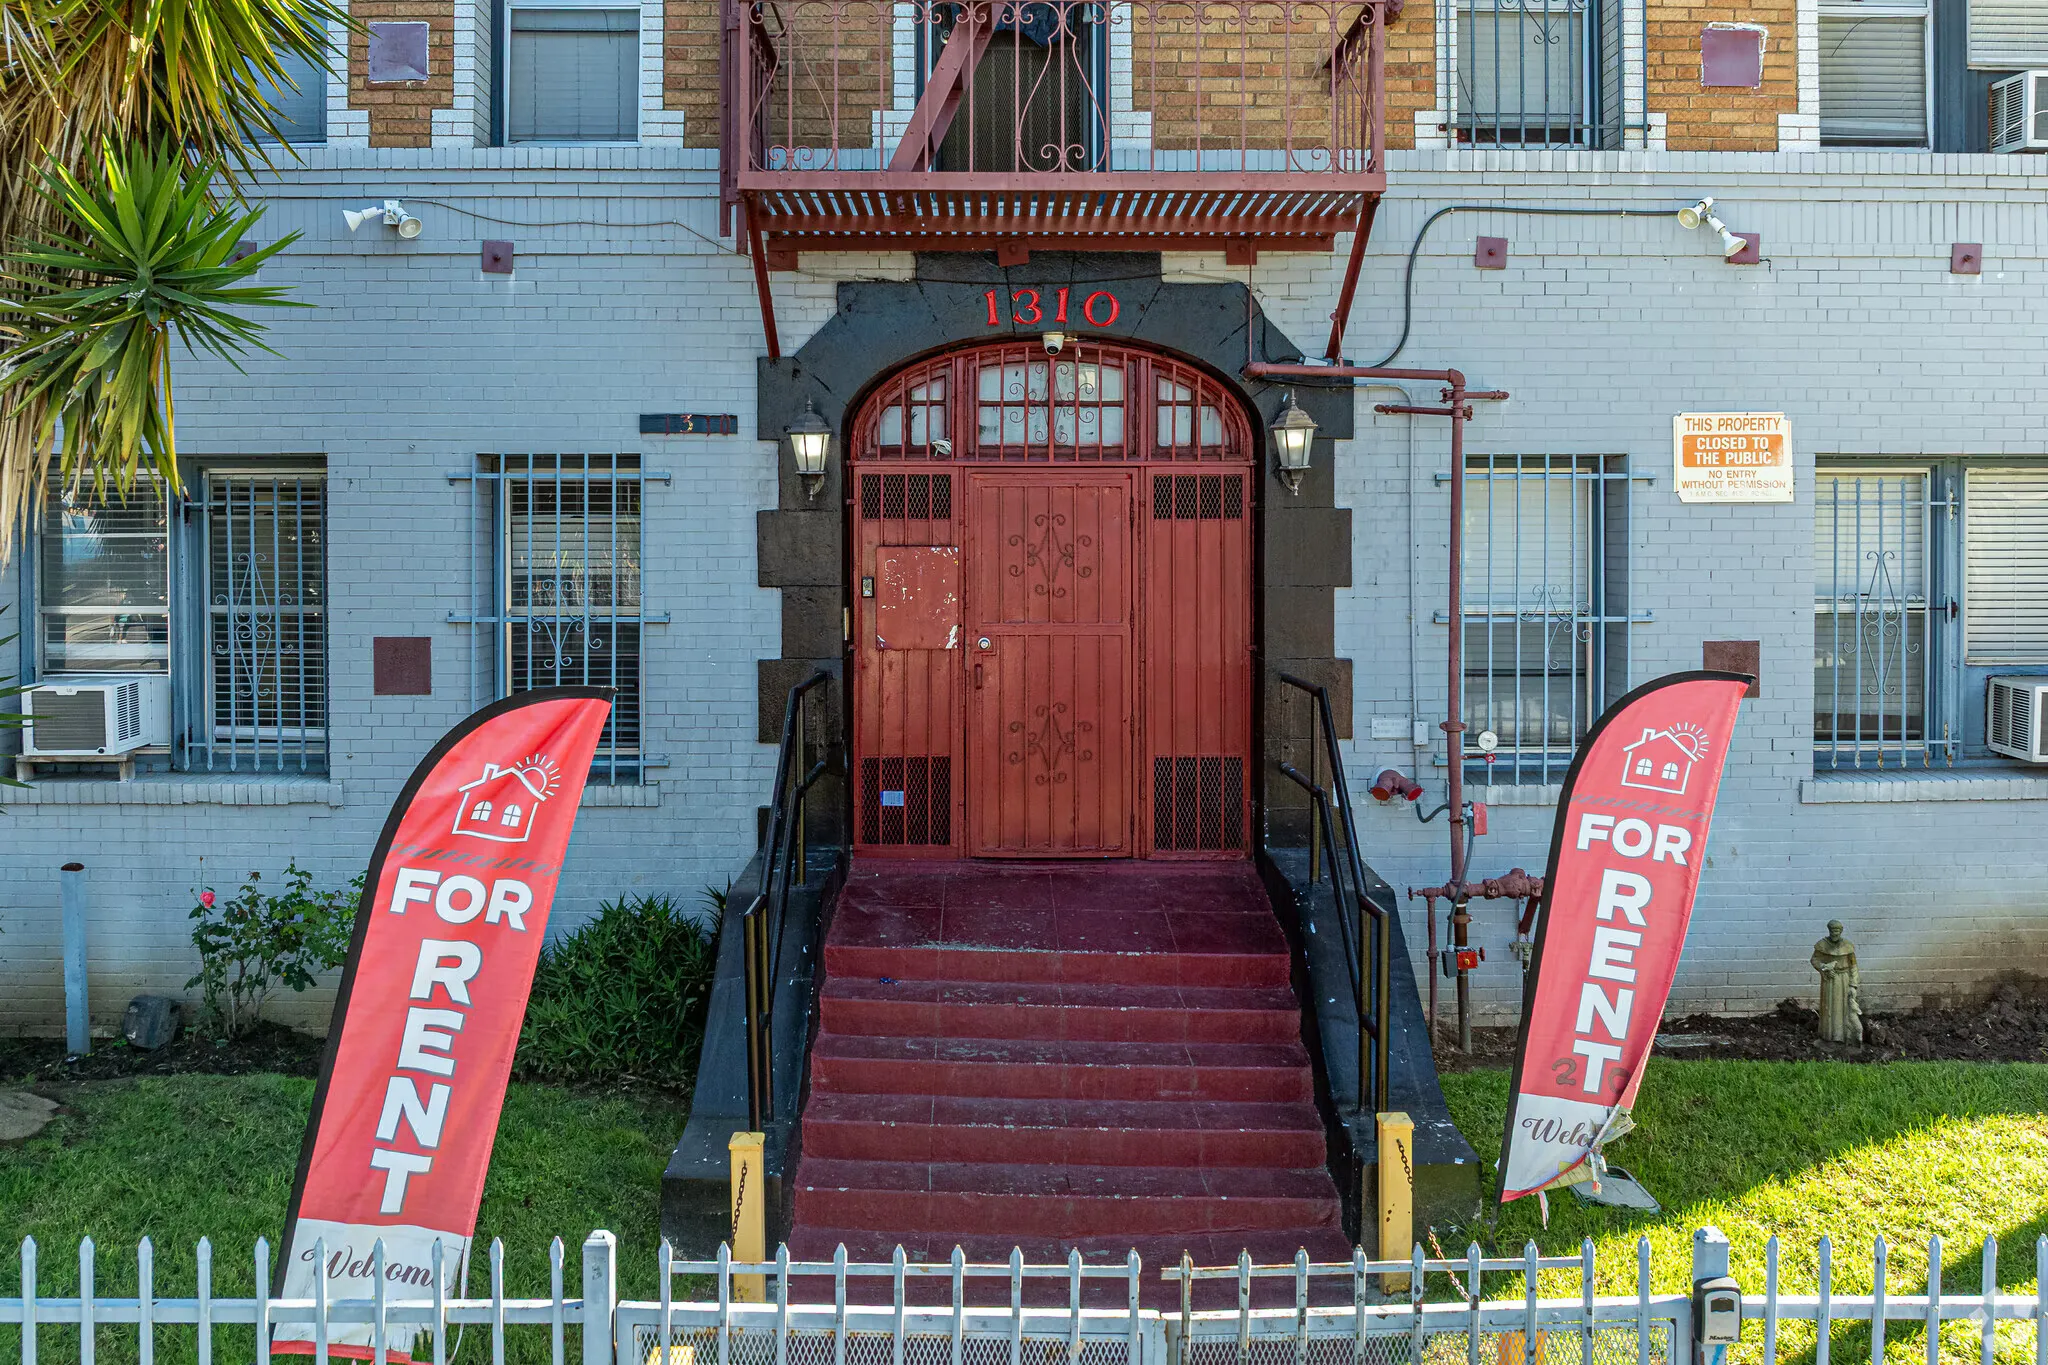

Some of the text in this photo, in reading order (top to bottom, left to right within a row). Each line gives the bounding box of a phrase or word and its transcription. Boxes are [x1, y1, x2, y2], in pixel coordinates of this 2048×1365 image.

[984, 287, 1120, 327] 1310
[1684, 417, 1781, 431] THIS PROPERTY
[1694, 451, 1772, 465] THE PUBLIC
[1696, 436, 1769, 450] CLOSED TO
[1681, 480, 1786, 489] WITHOUT PERMISSION
[1708, 469, 1757, 479] NO ENTRY
[1576, 812, 1693, 867] FOR
[389, 866, 534, 932] FOR
[1572, 867, 1653, 1095] RENT
[369, 937, 484, 1216] RENT
[1551, 1057, 1577, 1086] 2
[301, 1245, 456, 1292] Welom
